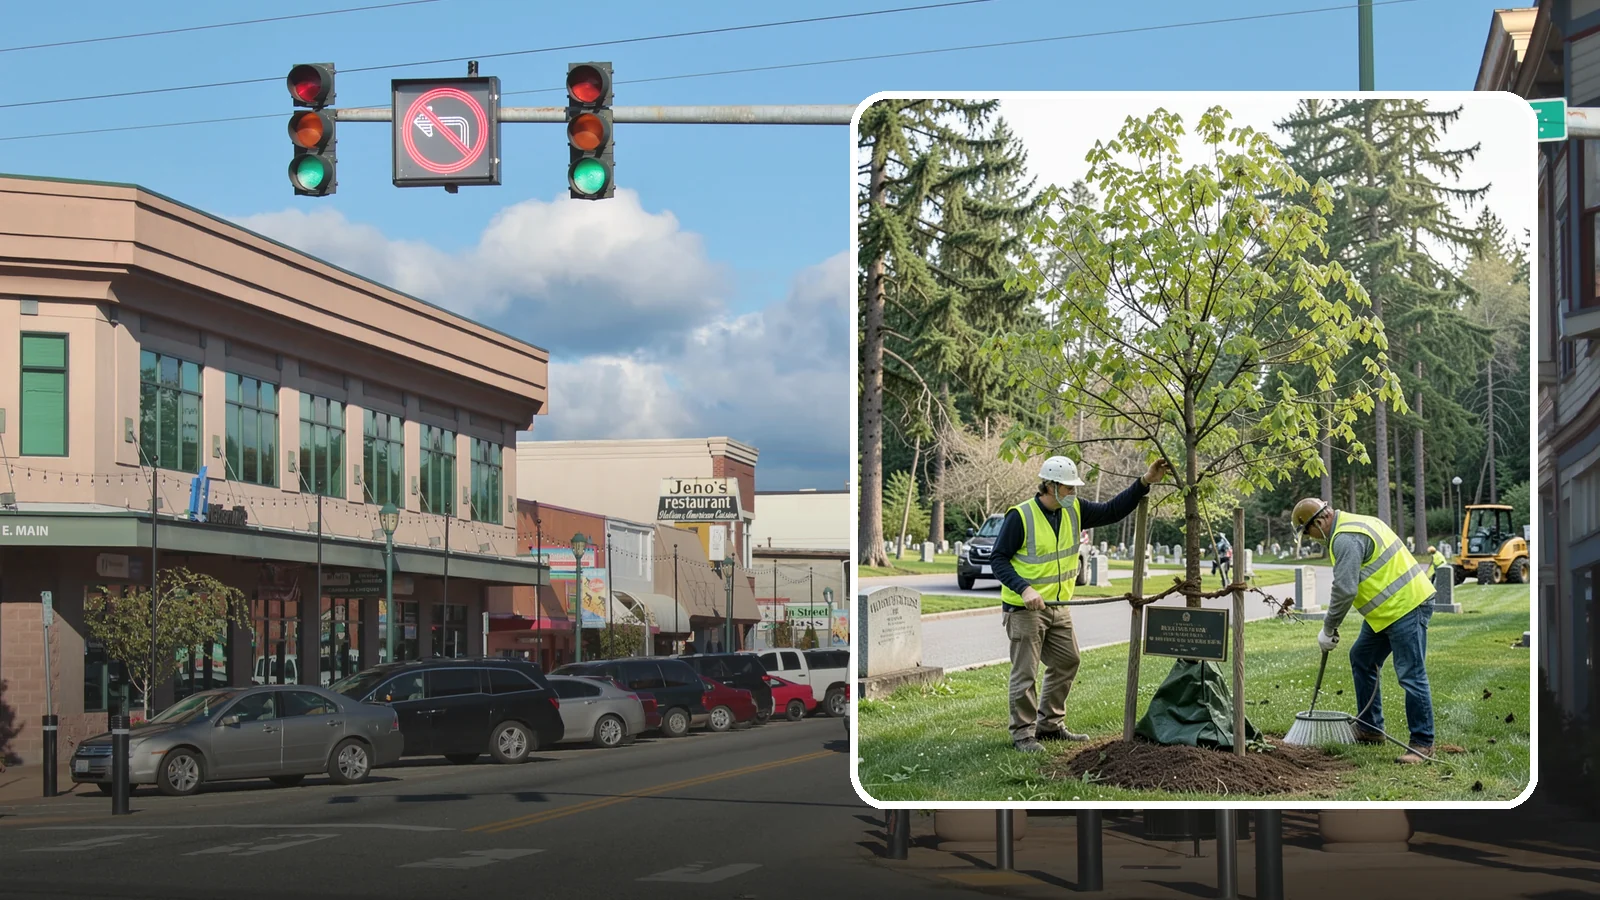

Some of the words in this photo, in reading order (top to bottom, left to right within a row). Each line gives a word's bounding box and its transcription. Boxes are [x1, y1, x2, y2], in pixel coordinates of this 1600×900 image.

[669, 480, 727, 495] Jeno's
[665, 496, 731, 509] restaurant
[686, 509, 714, 520] American
[715, 509, 737, 519] Cuisine
[2, 525, 13, 536] E.
[15, 525, 49, 536] MAIN
[797, 607, 828, 617] Street
[791, 619, 823, 627] lass
